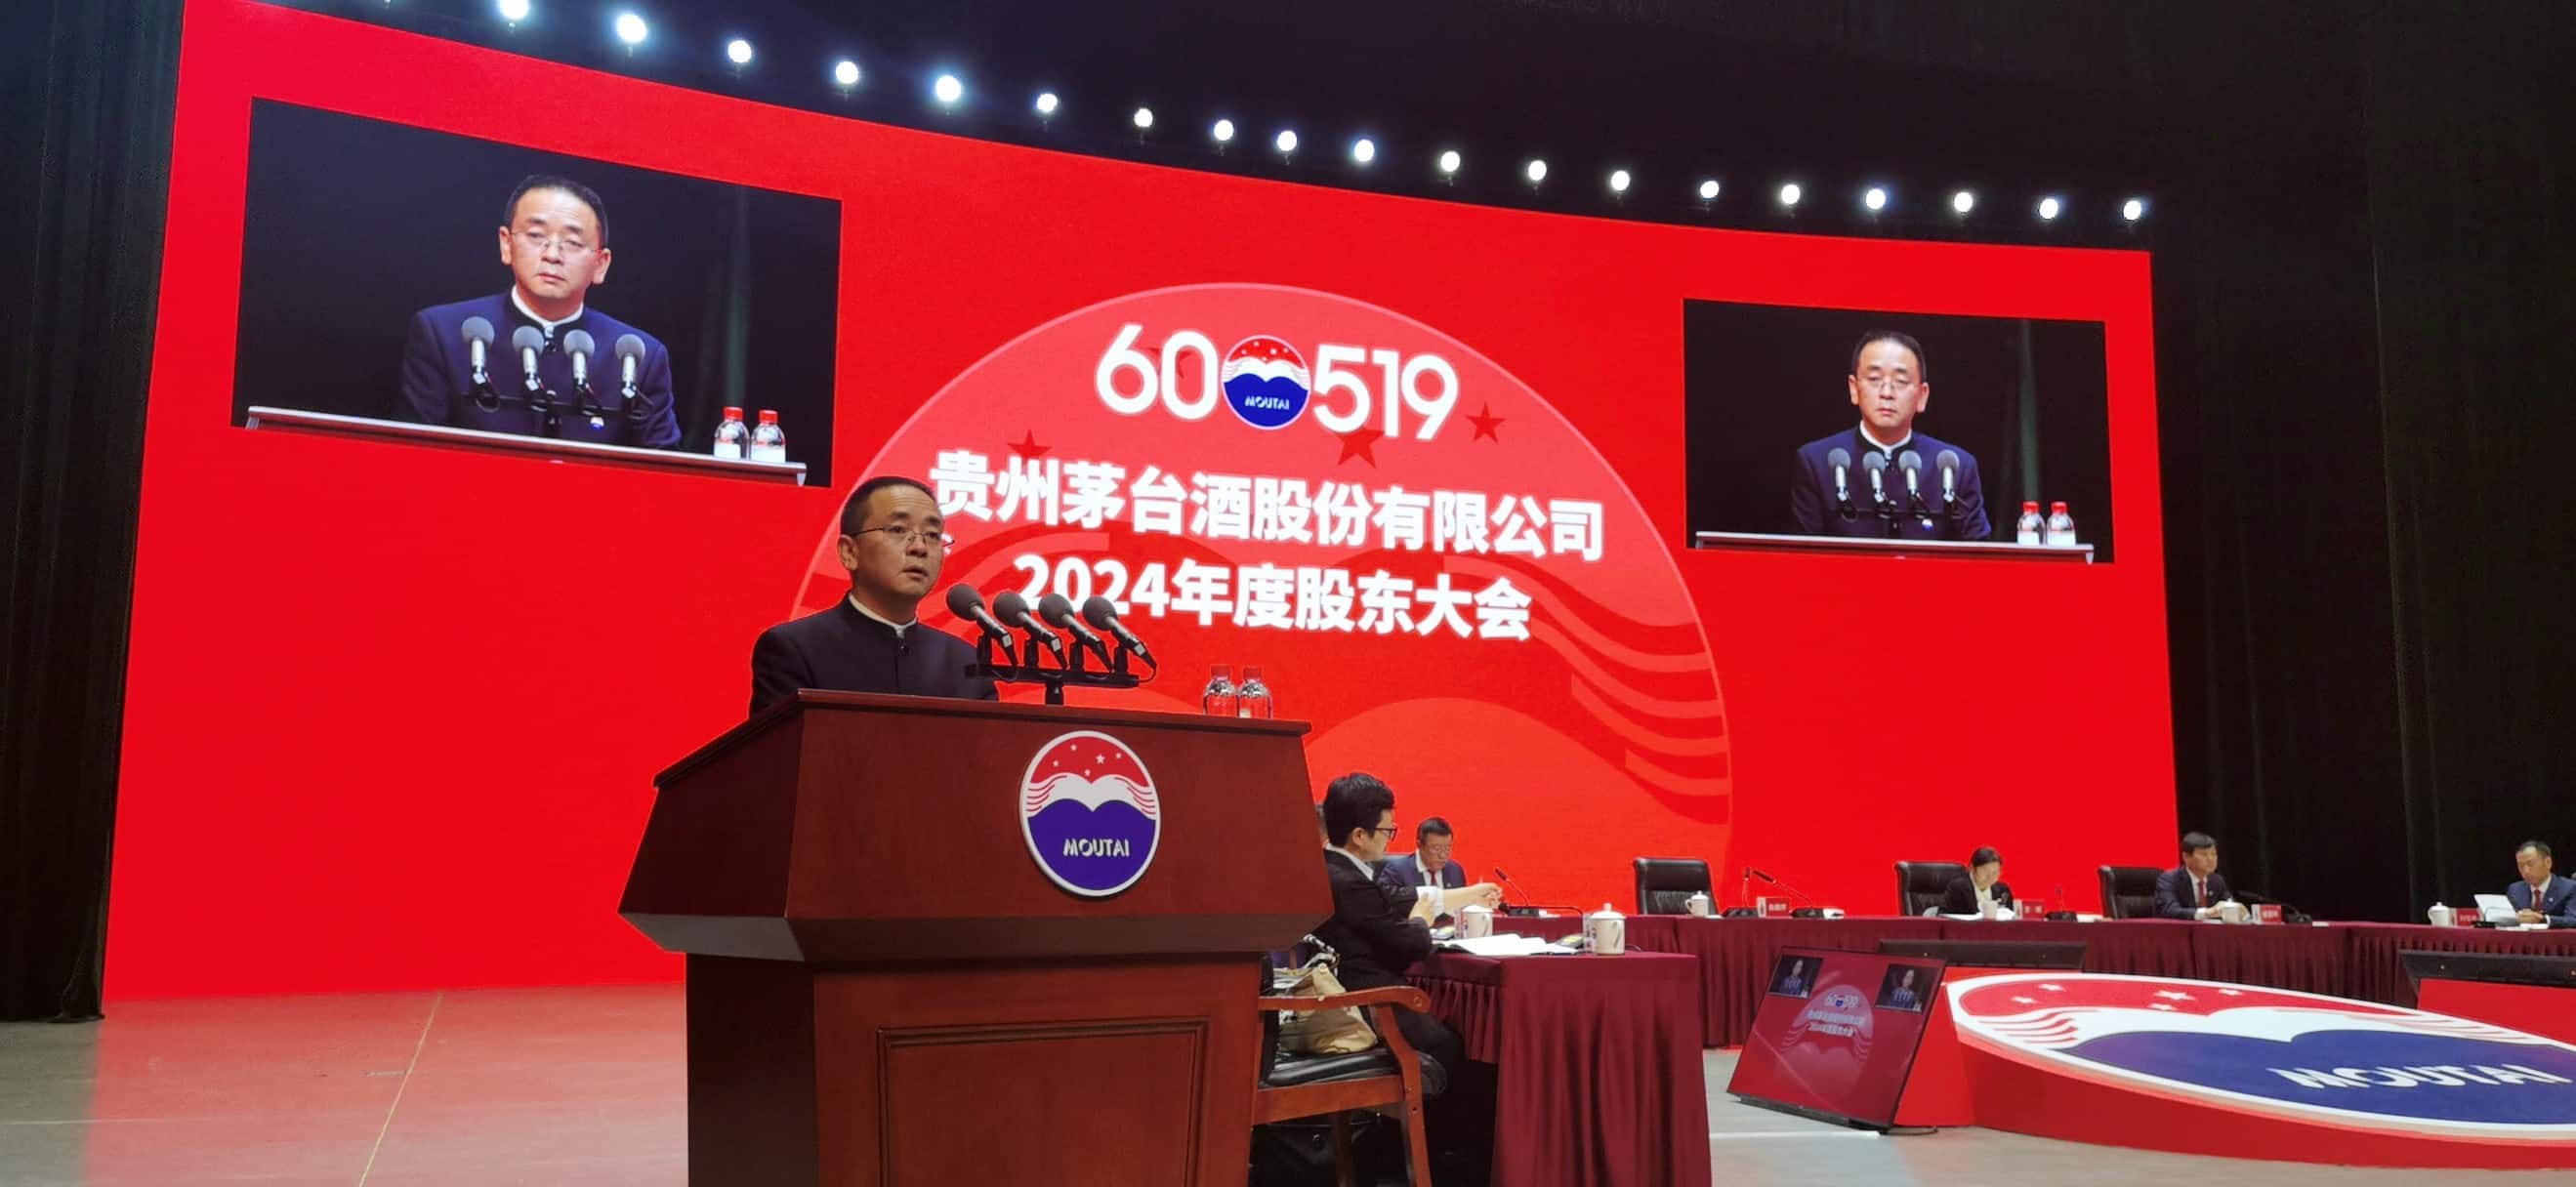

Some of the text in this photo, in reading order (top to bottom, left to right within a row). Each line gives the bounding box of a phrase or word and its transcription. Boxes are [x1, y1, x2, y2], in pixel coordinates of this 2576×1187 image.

[1245, 395, 1290, 410] MOUTAI
[930, 449, 1604, 563] 贵州茅台酒股份有限公司
[1013, 553, 1533, 641] 2024年度股东大会
[1062, 838, 1130, 857] MOUTAI
[2265, 1062, 2573, 1089] MOUTAI
